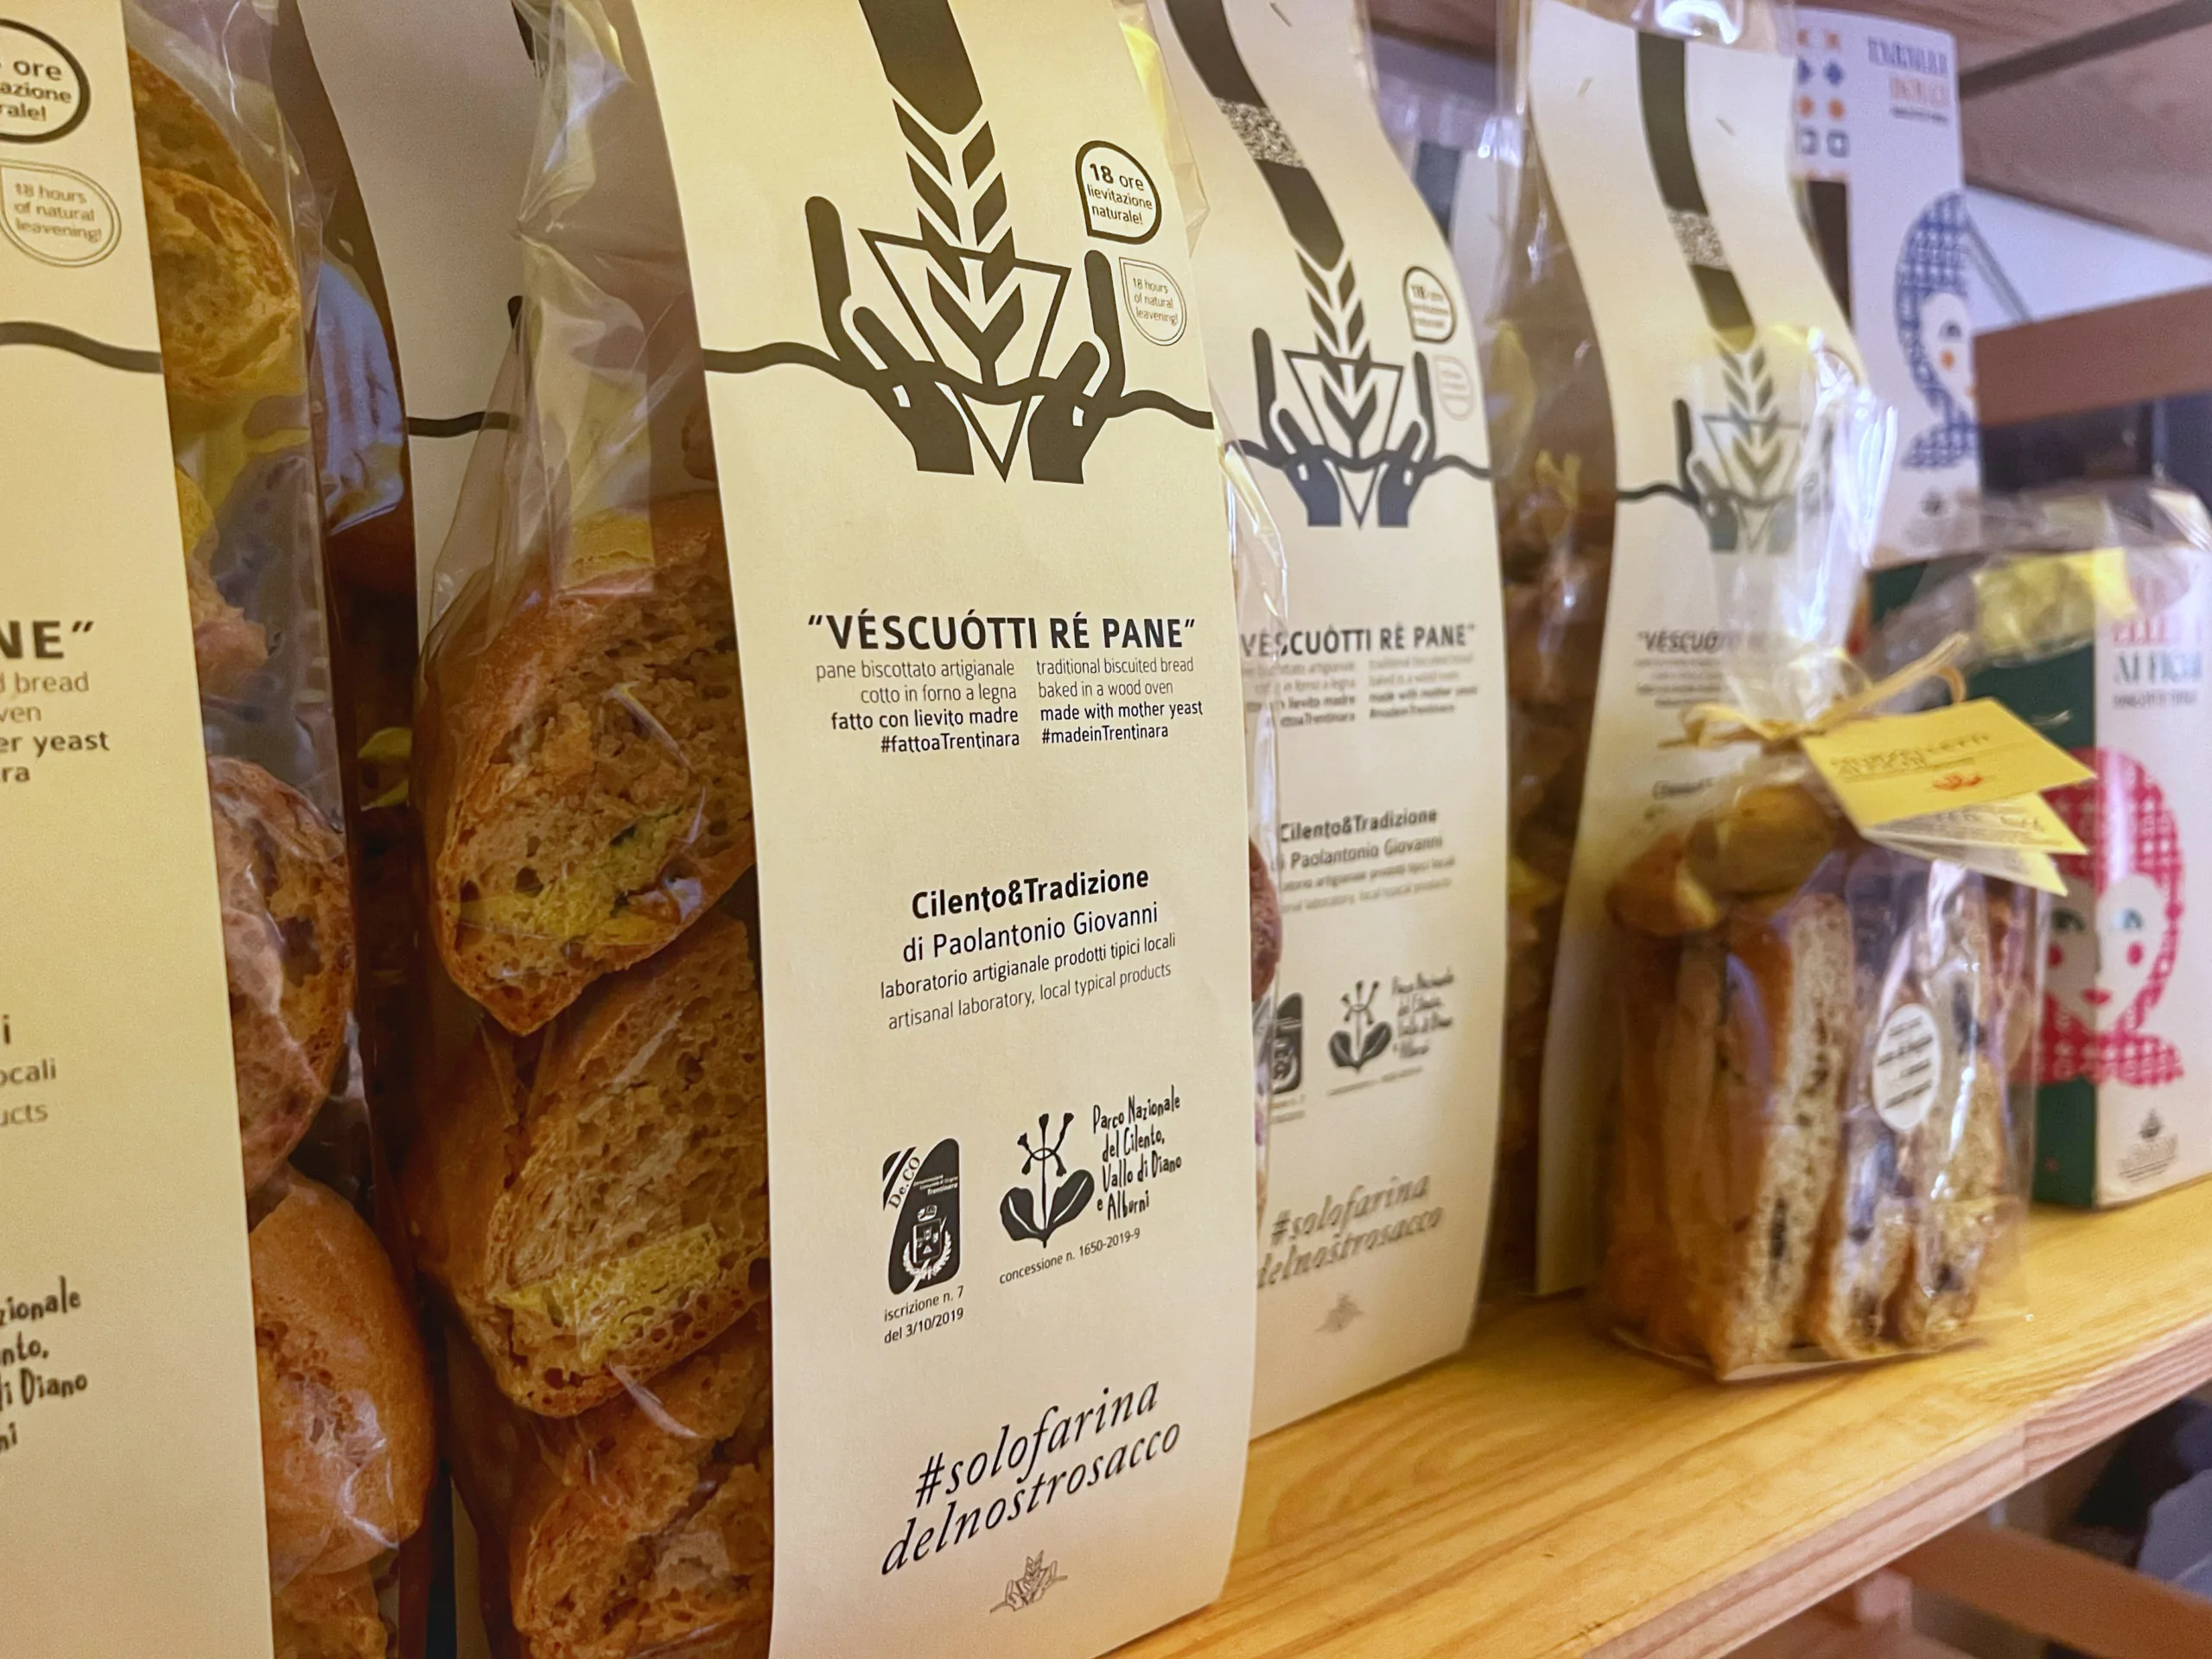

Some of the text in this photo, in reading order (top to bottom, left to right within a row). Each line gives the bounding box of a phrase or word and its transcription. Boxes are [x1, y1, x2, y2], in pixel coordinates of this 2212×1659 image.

[13, 60, 61, 81] ore
[1090, 163, 1144, 191] 18 ore
[39, 185, 86, 203] hours
[1087, 184, 1153, 210] lievitazione
[15, 201, 94, 221] of natural
[1092, 206, 1142, 225] naturale!
[16, 218, 101, 243] leavening!
[1133, 277, 1168, 294] 18 hours
[1135, 293, 1173, 308] of natural
[1136, 307, 1178, 326] leavening!
[1050, 612, 1090, 648] RÉ
[816, 658, 1014, 683] pane biscottato artigianale
[1037, 657, 1193, 675] traditional biscuited bread
[15, 671, 89, 693] bread
[861, 683, 1016, 704] cotto in forno a legna
[1039, 679, 1173, 698] baked in a wood oven
[0, 705, 41, 723] ven
[831, 706, 1018, 731] fatto con lievito madre
[1040, 701, 1203, 721] made with mother yeast
[33, 731, 110, 758] yeast
[880, 731, 1020, 753] #fattoaTrentinara
[1042, 723, 1168, 744] #madeinTrentinara
[1290, 842, 1379, 869] Paolantonio
[912, 868, 1149, 919] Cilento&Tradizione
[903, 901, 1157, 963] di Paolantonio Giovanni
[881, 932, 1175, 999] laboratorio artigianale prodotti tipici locali
[889, 963, 1171, 1030] artisanal laboratory, local typical products
[1093, 1084, 1180, 1135] Parco Nazionale
[1102, 1123, 1165, 1163] del Cilento,
[1102, 1150, 1182, 1192] Vallo di Diano
[1096, 1190, 1149, 1222] e Alburni
[1271, 1174, 1430, 1246] #solofarina
[1000, 1228, 1140, 1284] concessione n. 1650-2019-9
[1257, 1206, 1444, 1289] delnostrosacco
[884, 1285, 963, 1322] iscrizione n. 7
[884, 1306, 964, 1344] del 3/10/2019
[20, 1368, 88, 1406] Diano
[915, 1380, 1160, 1508] #solofarina
[881, 1423, 1180, 1575] delnostrosacco
